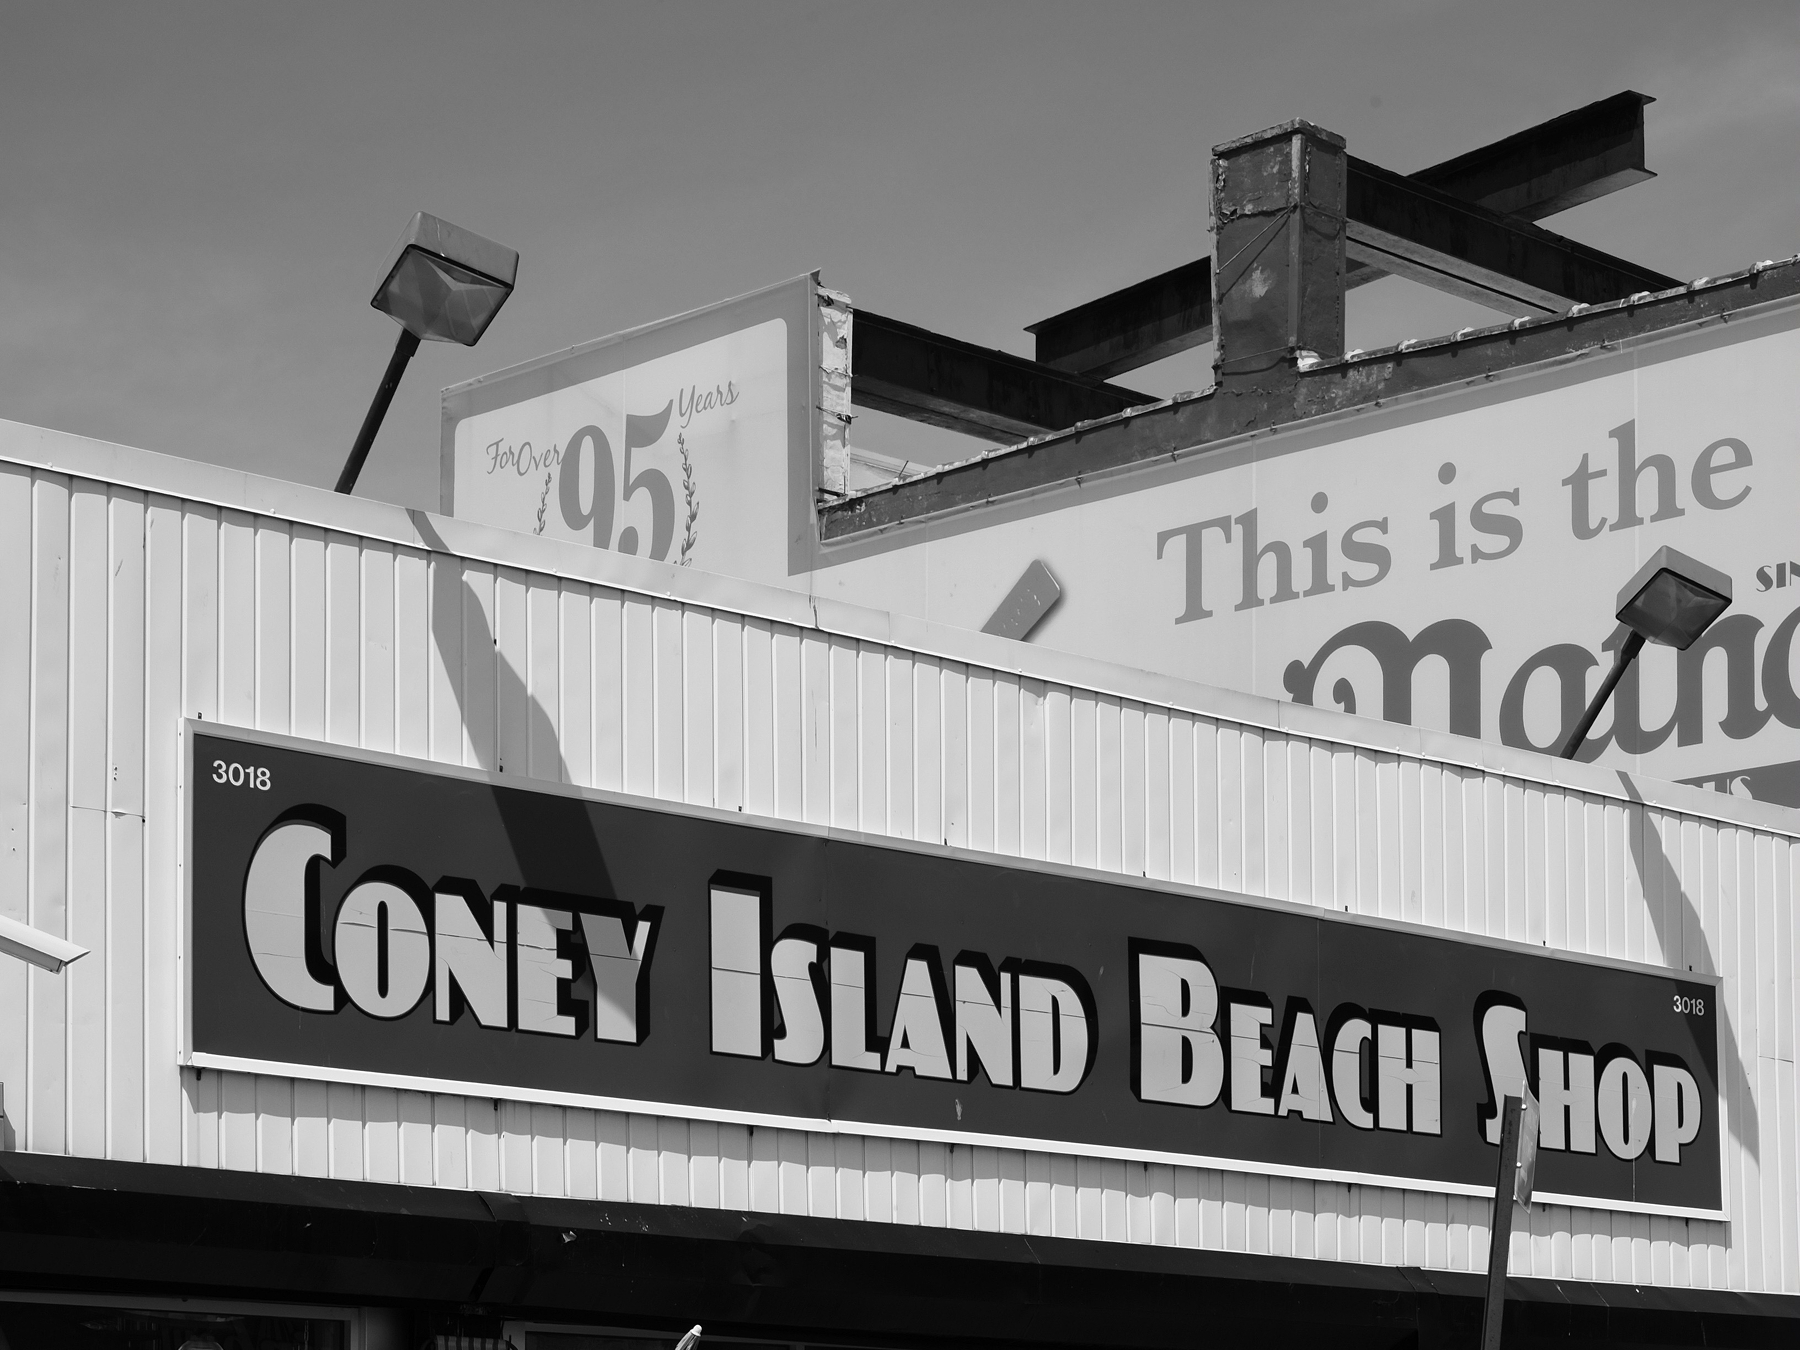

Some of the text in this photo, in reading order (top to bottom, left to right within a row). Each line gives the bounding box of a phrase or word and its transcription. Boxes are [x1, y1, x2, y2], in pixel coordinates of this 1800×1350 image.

[558, 398, 675, 562] 95
[678, 379, 740, 430] Years
[1157, 418, 1753, 625] This is the
[211, 759, 272, 792] 3018
[243, 806, 1704, 1166] CONEY ISLAND BEACH SHOP
[1672, 994, 1706, 1016] 3018
